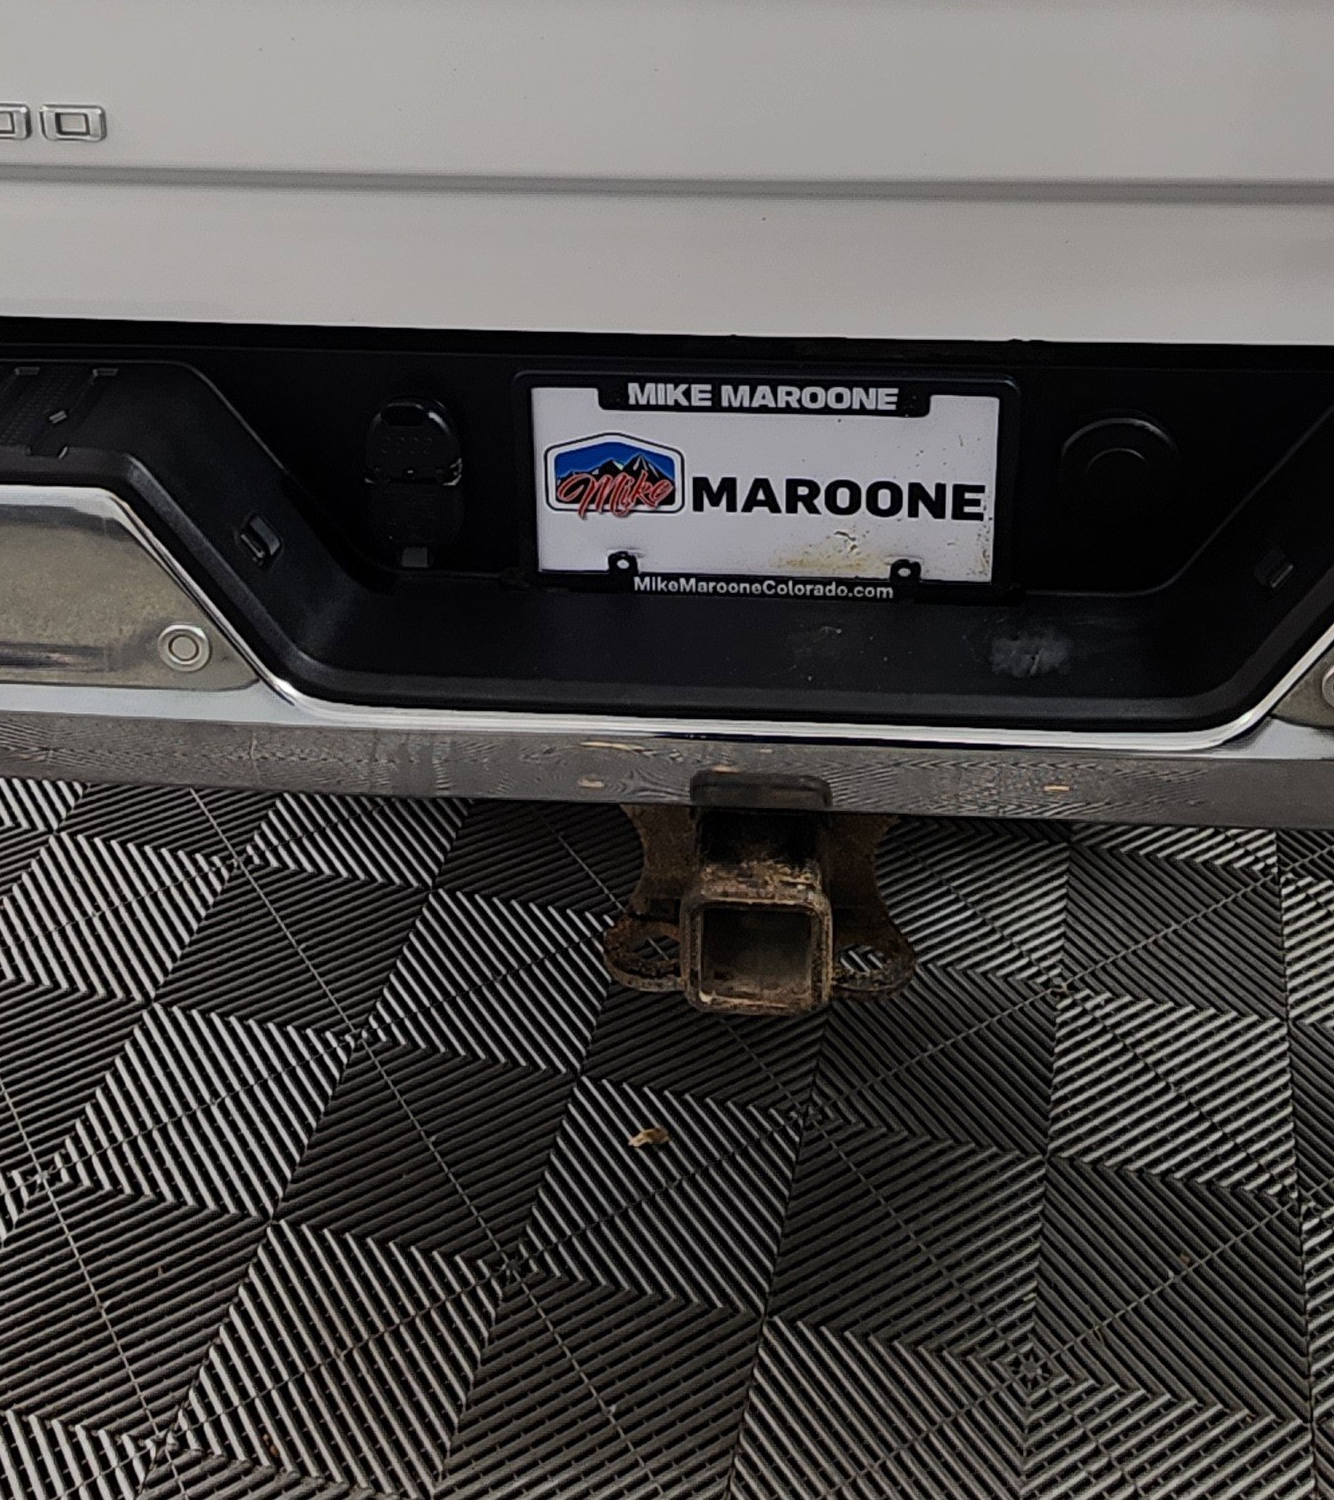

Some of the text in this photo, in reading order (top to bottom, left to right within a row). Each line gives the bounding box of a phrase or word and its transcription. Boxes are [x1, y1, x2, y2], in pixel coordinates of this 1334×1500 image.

[628, 383, 899, 411] MIKE MAROONE
[557, 470, 986, 521] Mike MAROONE
[633, 576, 894, 599] MikeMarooneColorado.com
